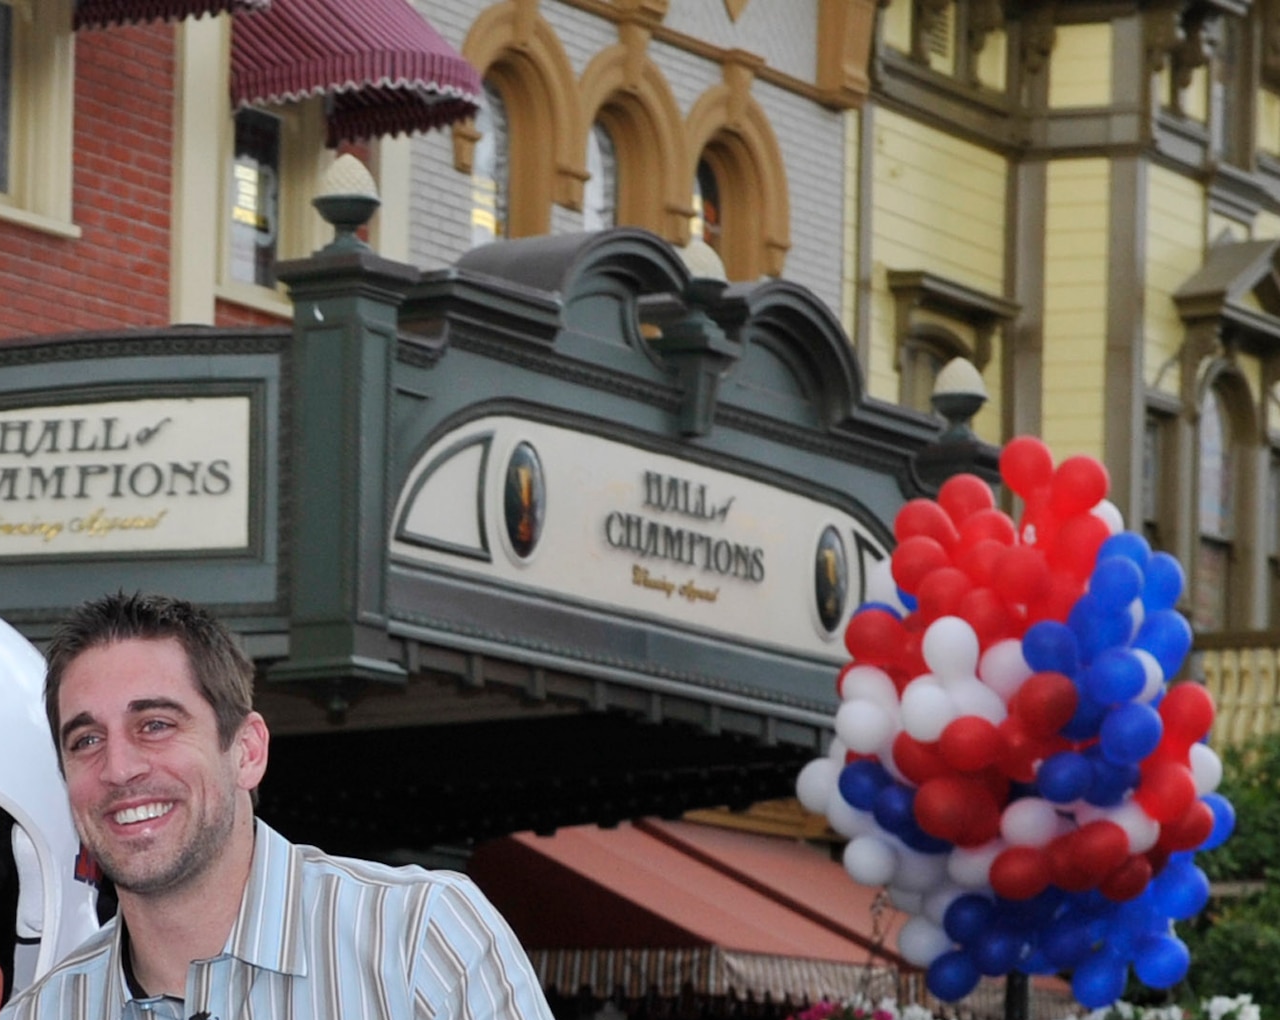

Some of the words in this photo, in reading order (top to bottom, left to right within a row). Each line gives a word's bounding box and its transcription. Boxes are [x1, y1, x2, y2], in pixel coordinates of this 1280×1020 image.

[135, 418, 171, 446] of
[644, 470, 715, 520] HALL
[605, 510, 765, 583] CHAMPIONS
